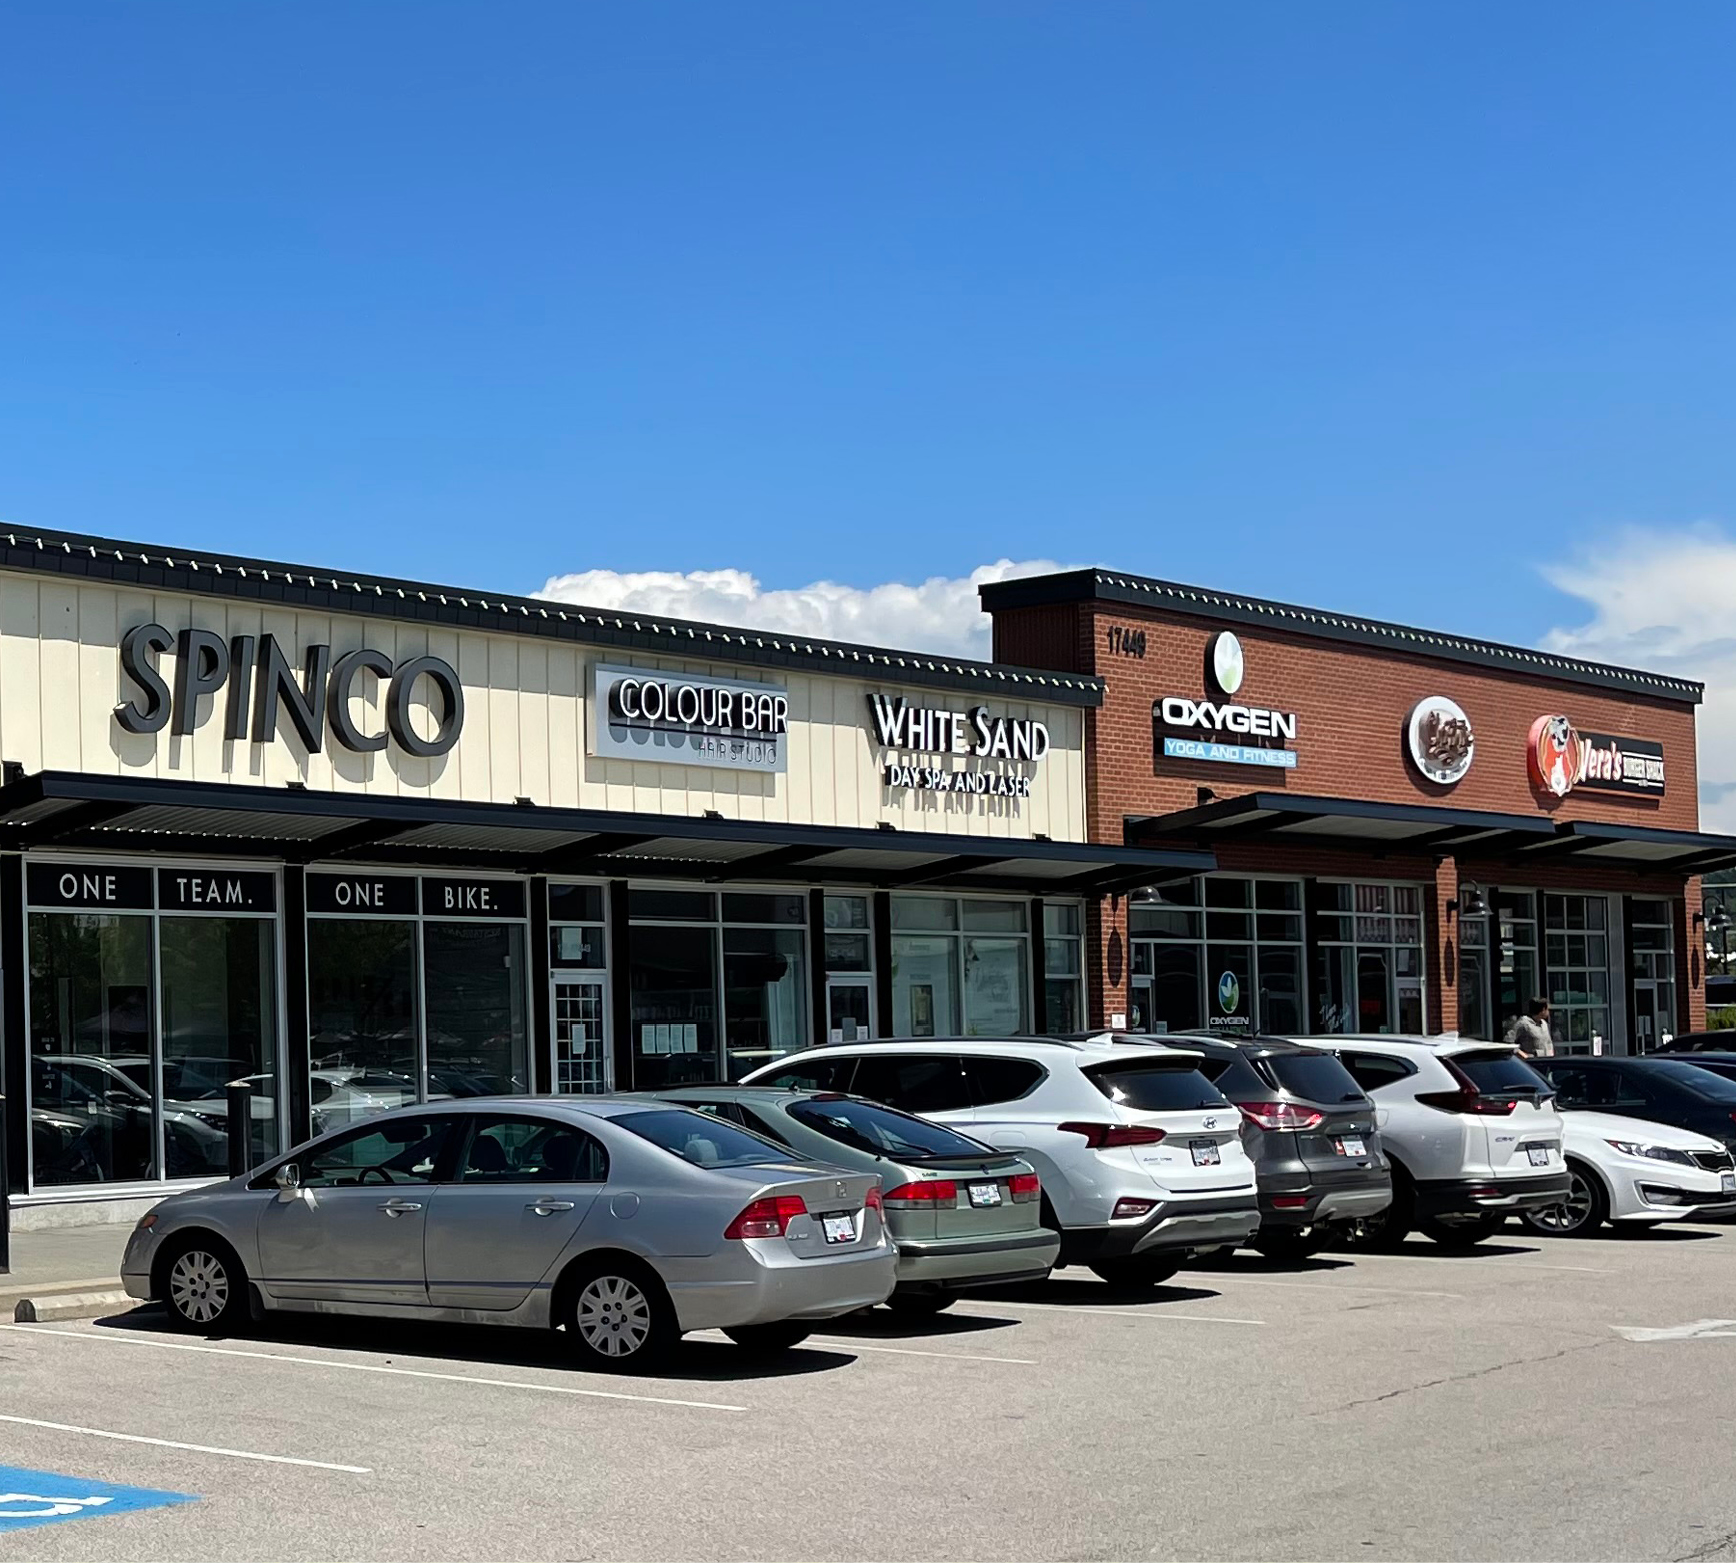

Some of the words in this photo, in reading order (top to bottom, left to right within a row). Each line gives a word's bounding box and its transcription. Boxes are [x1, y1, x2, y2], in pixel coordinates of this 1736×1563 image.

[114, 624, 465, 757] SPINCO
[616, 678, 732, 727] COLOUR
[741, 692, 788, 733] BAR
[870, 694, 966, 754] WHITE
[974, 706, 1050, 762] SAND
[1162, 697, 1297, 739] OXYGEN
[698, 742, 727, 761] HAIR
[731, 744, 776, 765] STUDIO
[1166, 740, 1206, 757] YOGA
[1210, 744, 1239, 760] AND
[1243, 749, 1295, 765] FITNESS
[1578, 738, 1622, 782] Vera's
[890, 765, 919, 787] DAY
[924, 768, 949, 790] SPA
[955, 771, 986, 794] AND
[987, 771, 1030, 797] LASER
[59, 873, 116, 900] ONE
[177, 878, 253, 904] TEAM.
[335, 882, 384, 906] ONE
[444, 886, 498, 910] BIKE.
[1210, 1017, 1249, 1025] OXYGEN
